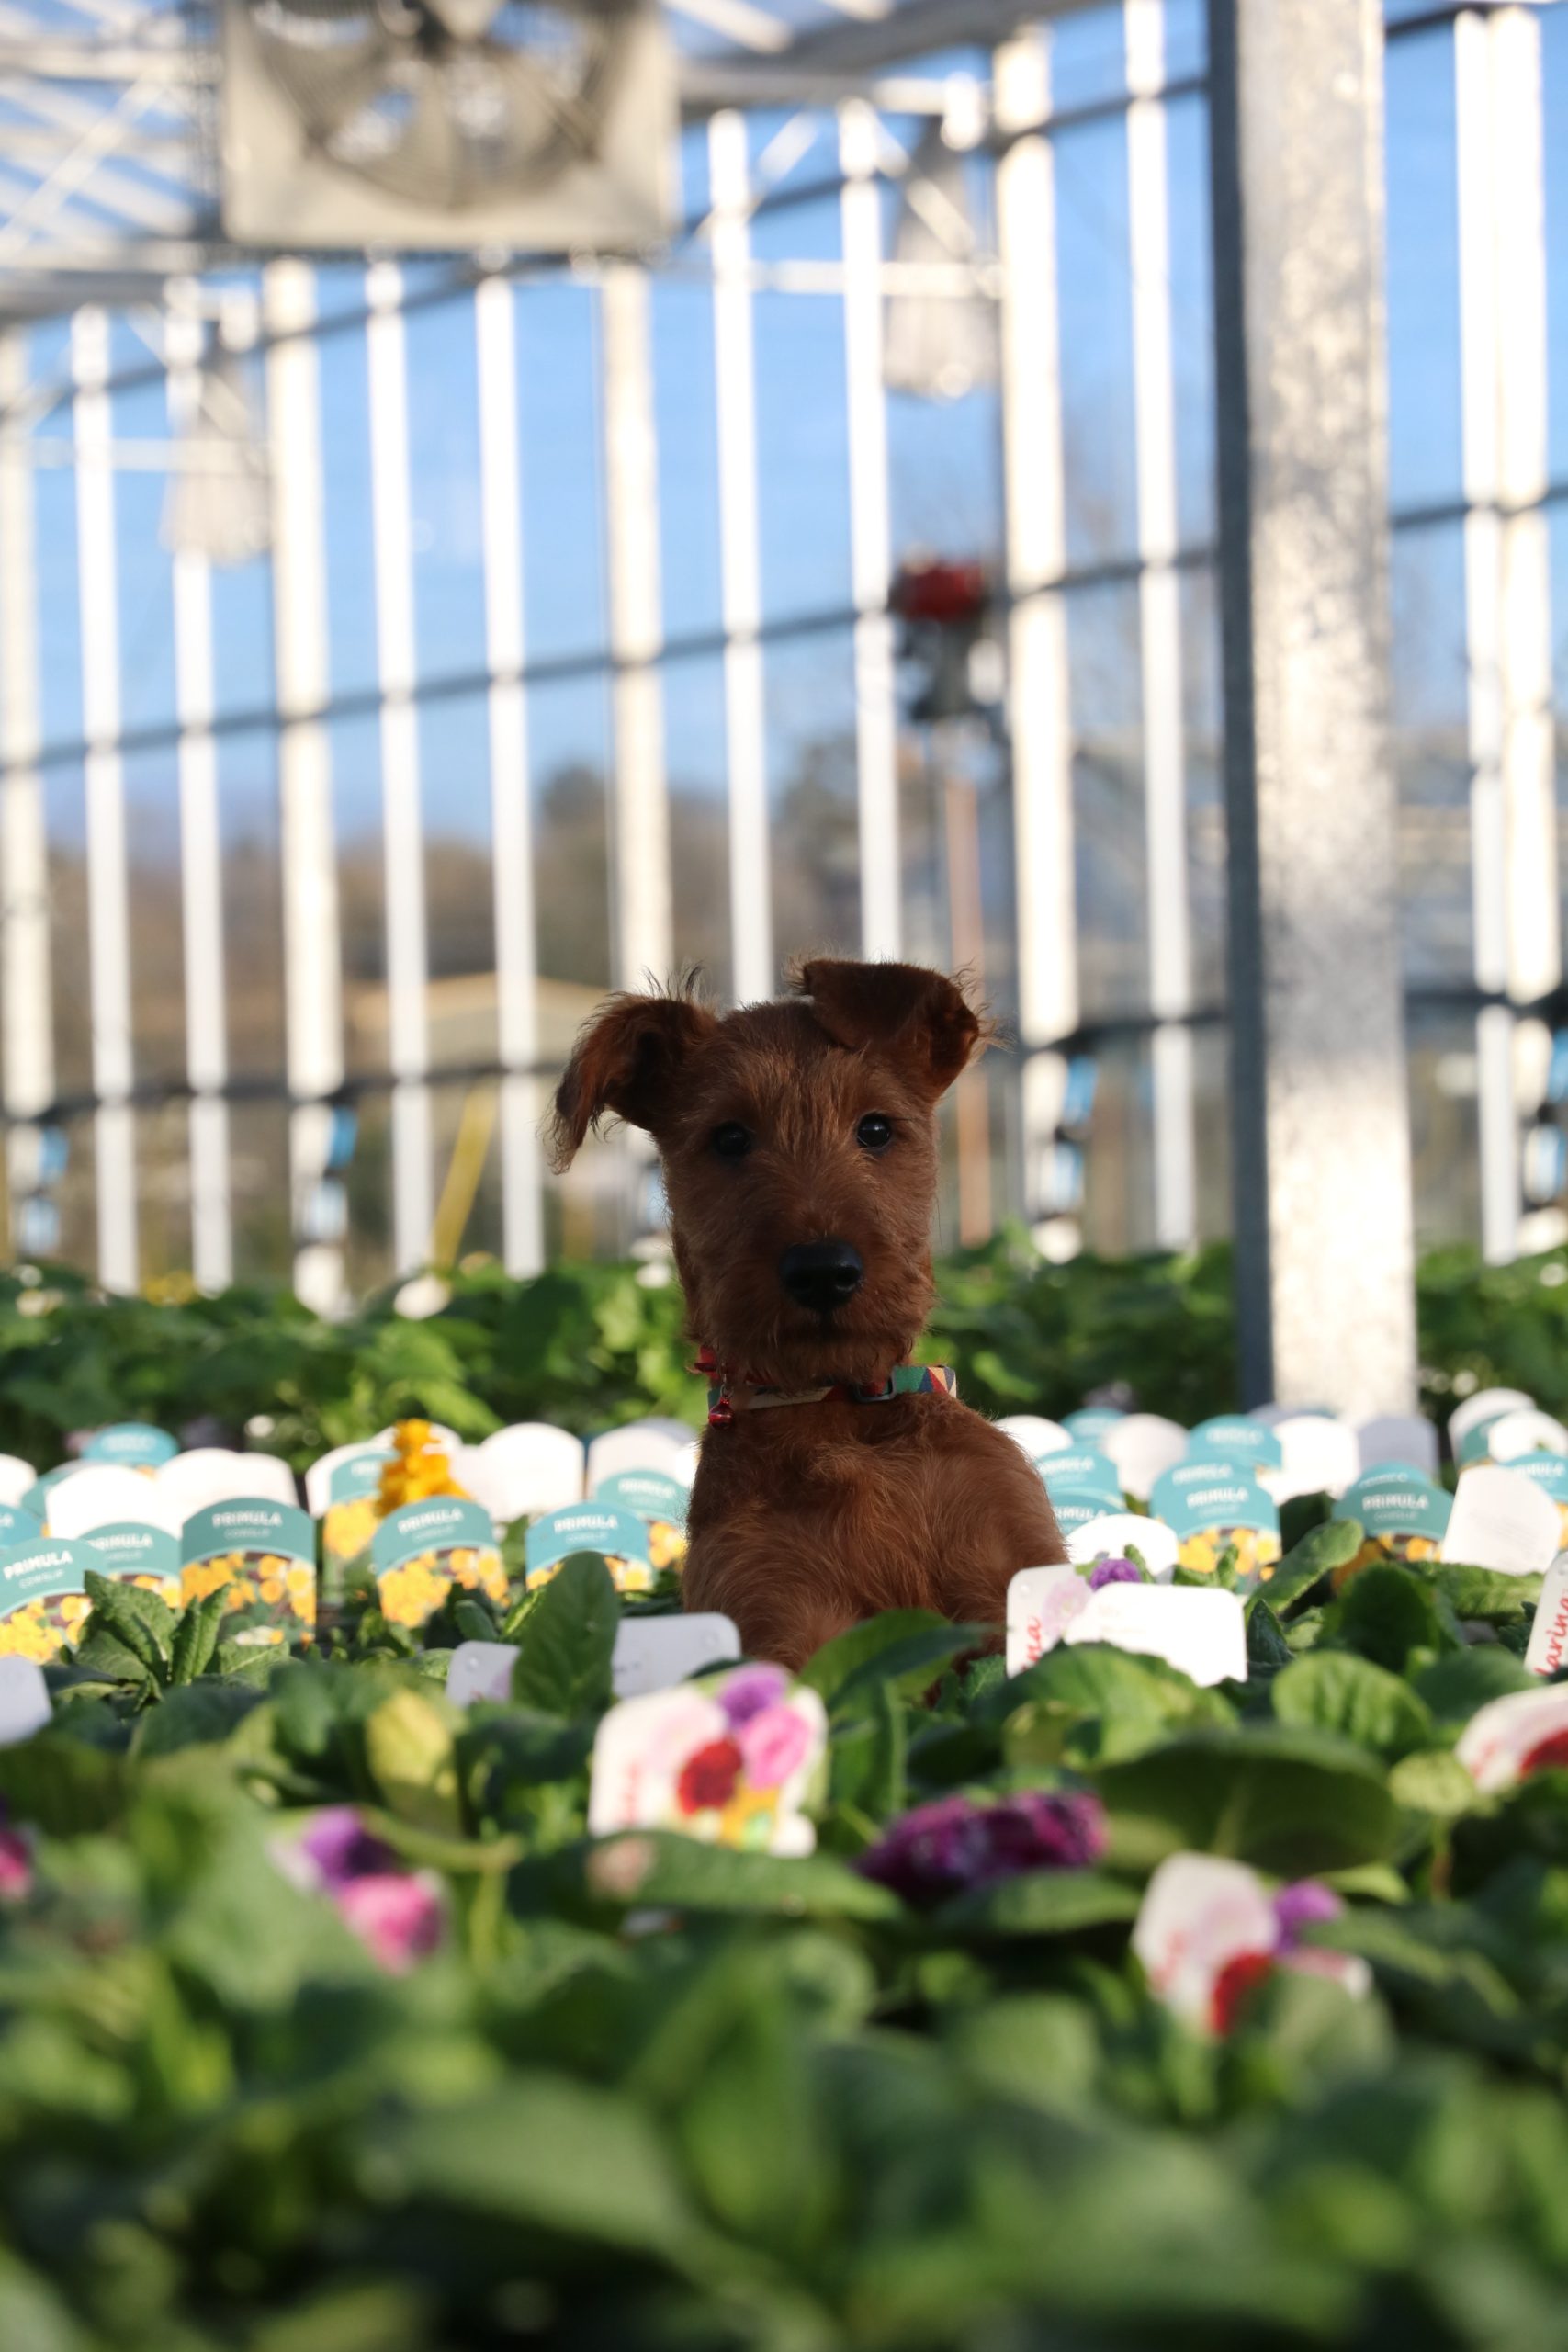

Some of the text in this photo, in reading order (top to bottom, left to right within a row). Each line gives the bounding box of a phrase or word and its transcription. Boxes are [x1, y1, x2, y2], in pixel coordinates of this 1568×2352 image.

[1362, 1493, 1428, 1511] PRIMULA
[211, 1510, 282, 1527] PRIMULA
[398, 1507, 464, 1534] PRIMULA
[554, 1514, 618, 1532] PRIMULA
[3, 1550, 73, 1579] PRIMULA
